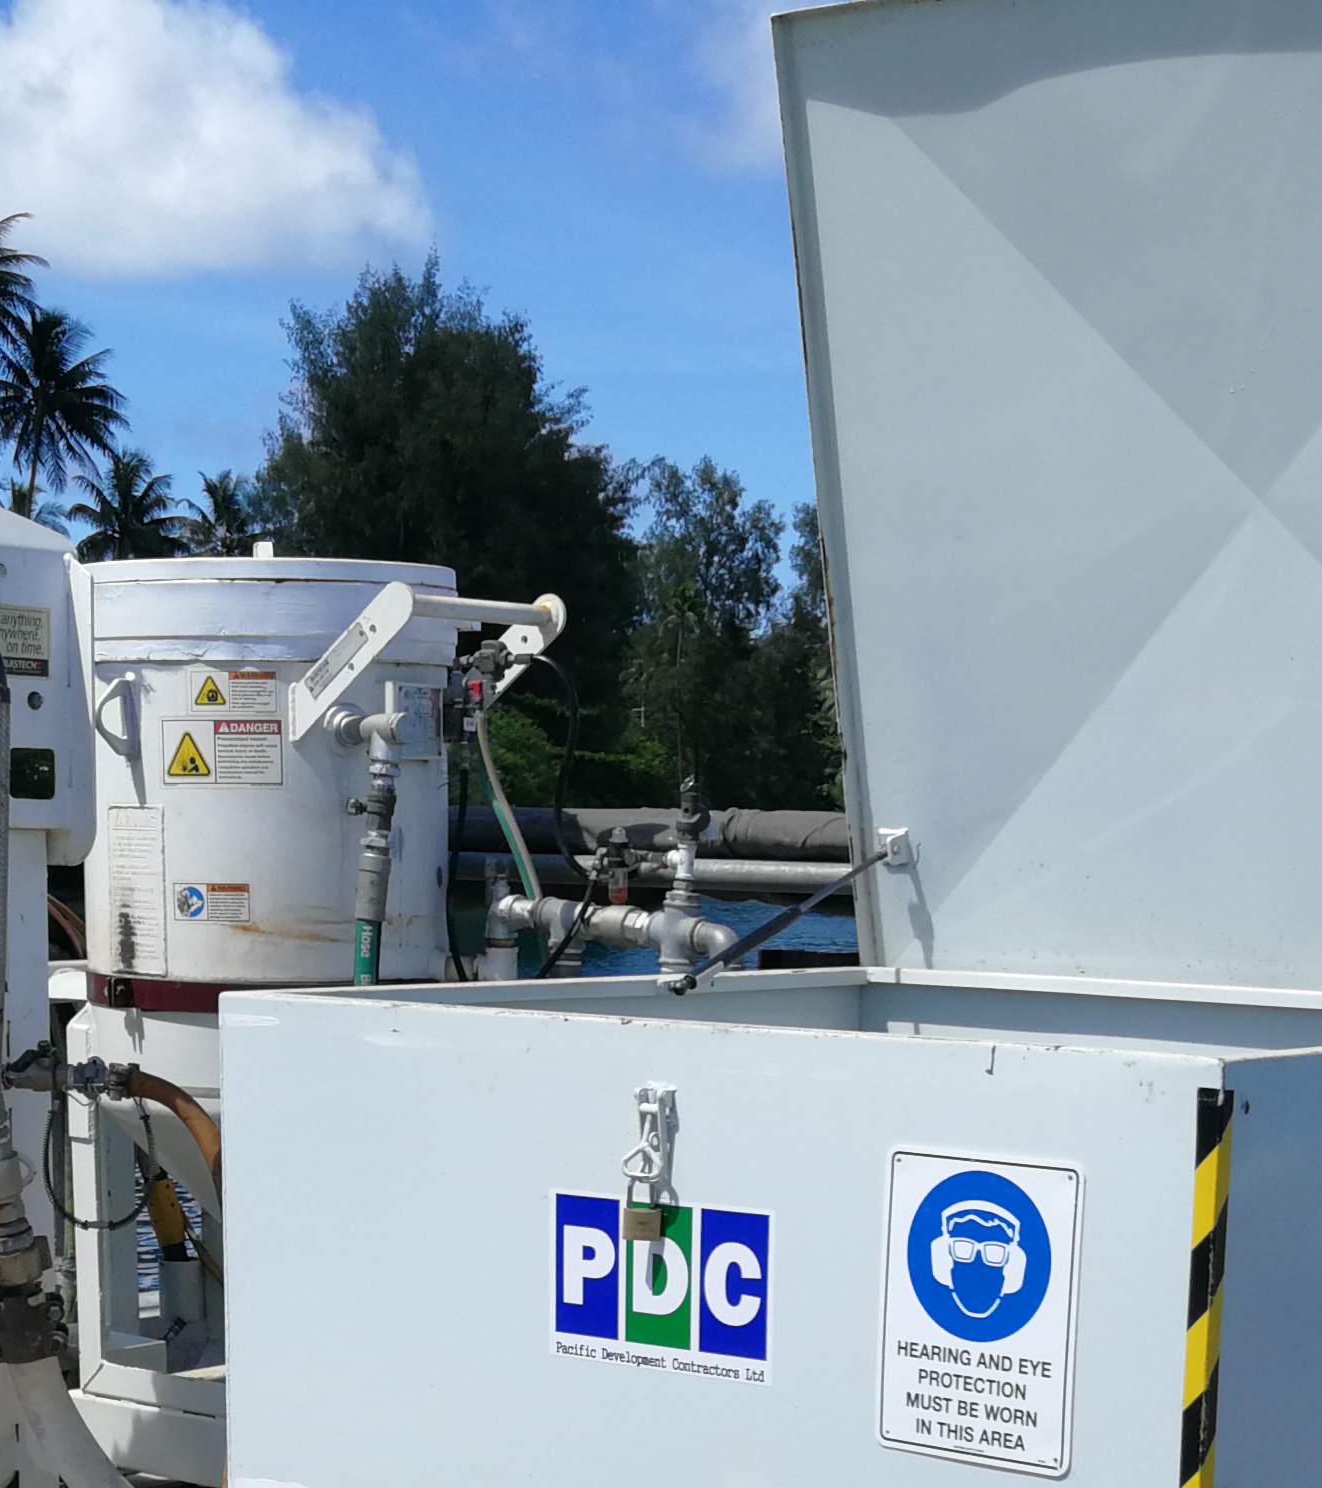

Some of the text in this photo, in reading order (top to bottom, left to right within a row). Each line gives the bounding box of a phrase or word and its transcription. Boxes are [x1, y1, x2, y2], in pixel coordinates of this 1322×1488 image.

[6, 641, 44, 655] on time.
[230, 723, 278, 733] DANGER
[360, 925, 373, 958] Hose
[563, 1224, 762, 1327] PDC
[556, 1341, 765, 1382] Pacific Development Contractors Ltd
[897, 1340, 1052, 1378] HEARING AND EYE
[918, 1369, 1027, 1400] PROTECTION
[906, 1392, 1037, 1428] MUST BE WORN
[916, 1418, 932, 1435] IN
[937, 1421, 974, 1443] THIS
[979, 1429, 1025, 1451] AREA
